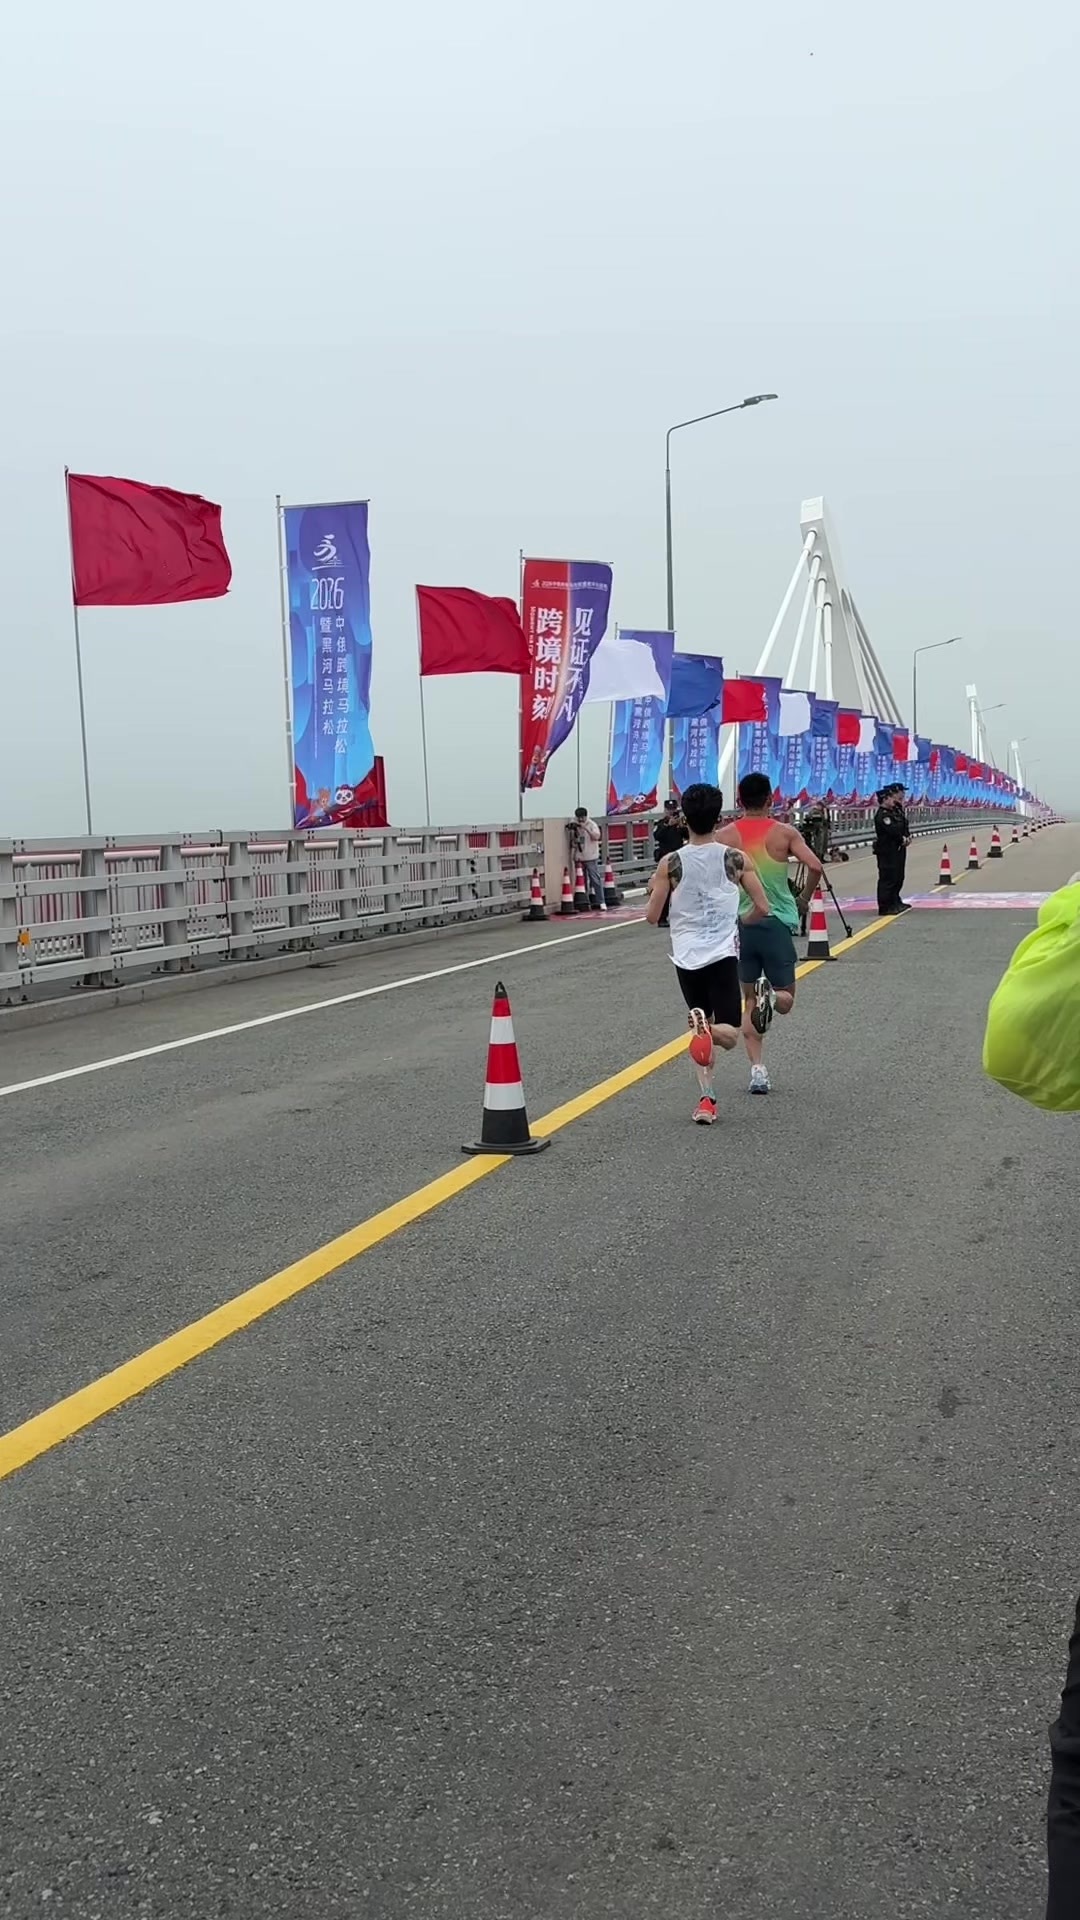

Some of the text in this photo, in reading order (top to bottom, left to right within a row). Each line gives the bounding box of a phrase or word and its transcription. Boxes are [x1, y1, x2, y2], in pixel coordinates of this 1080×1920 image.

[310, 577, 345, 610] 2026
[320, 617, 334, 736] 暨黑河马拉松
[335, 615, 349, 754] 中俄跨境马拉松
[531, 607, 563, 722] 跨境时刻
[555, 607, 594, 722] 见证不凡
